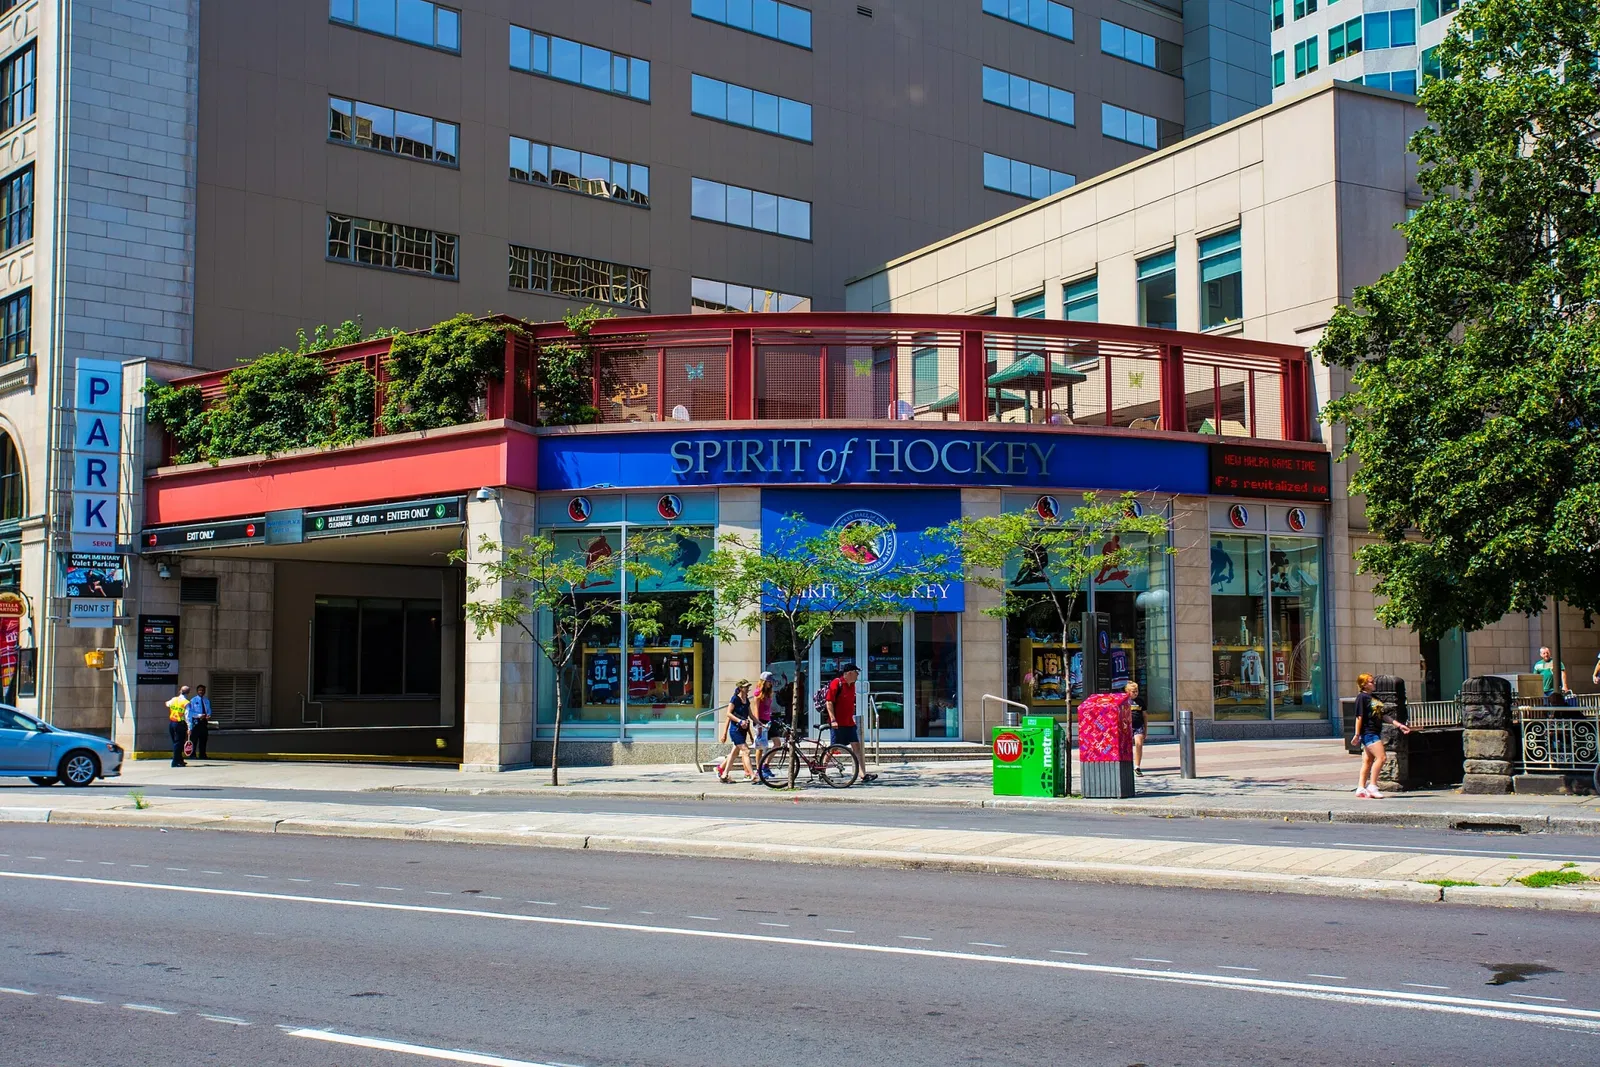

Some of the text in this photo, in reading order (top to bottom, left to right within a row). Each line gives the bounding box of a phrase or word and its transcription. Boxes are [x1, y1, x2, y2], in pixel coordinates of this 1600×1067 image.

[85, 377, 110, 528] PARK
[670, 437, 1056, 484] SPIRIT of HOCKEY
[1225, 455, 1242, 466] NEW
[1272, 458, 1293, 470] GAME
[1296, 460, 1316, 471] TIME
[1243, 478, 1308, 493] revitalized
[355, 508, 430, 525] 4.09 m ENTER ONLY
[187, 530, 215, 541] EXIT ONLY
[71, 553, 121, 561] COMPLIMENTARY
[92, 560, 120, 568] Parking
[74, 604, 110, 612] FRONT ST
[144, 660, 171, 669] Monthly
[595, 666, 607, 680] 91
[670, 667, 681, 681] 10
[997, 742, 1019, 755] NOW
[1043, 728, 1052, 768] metro
